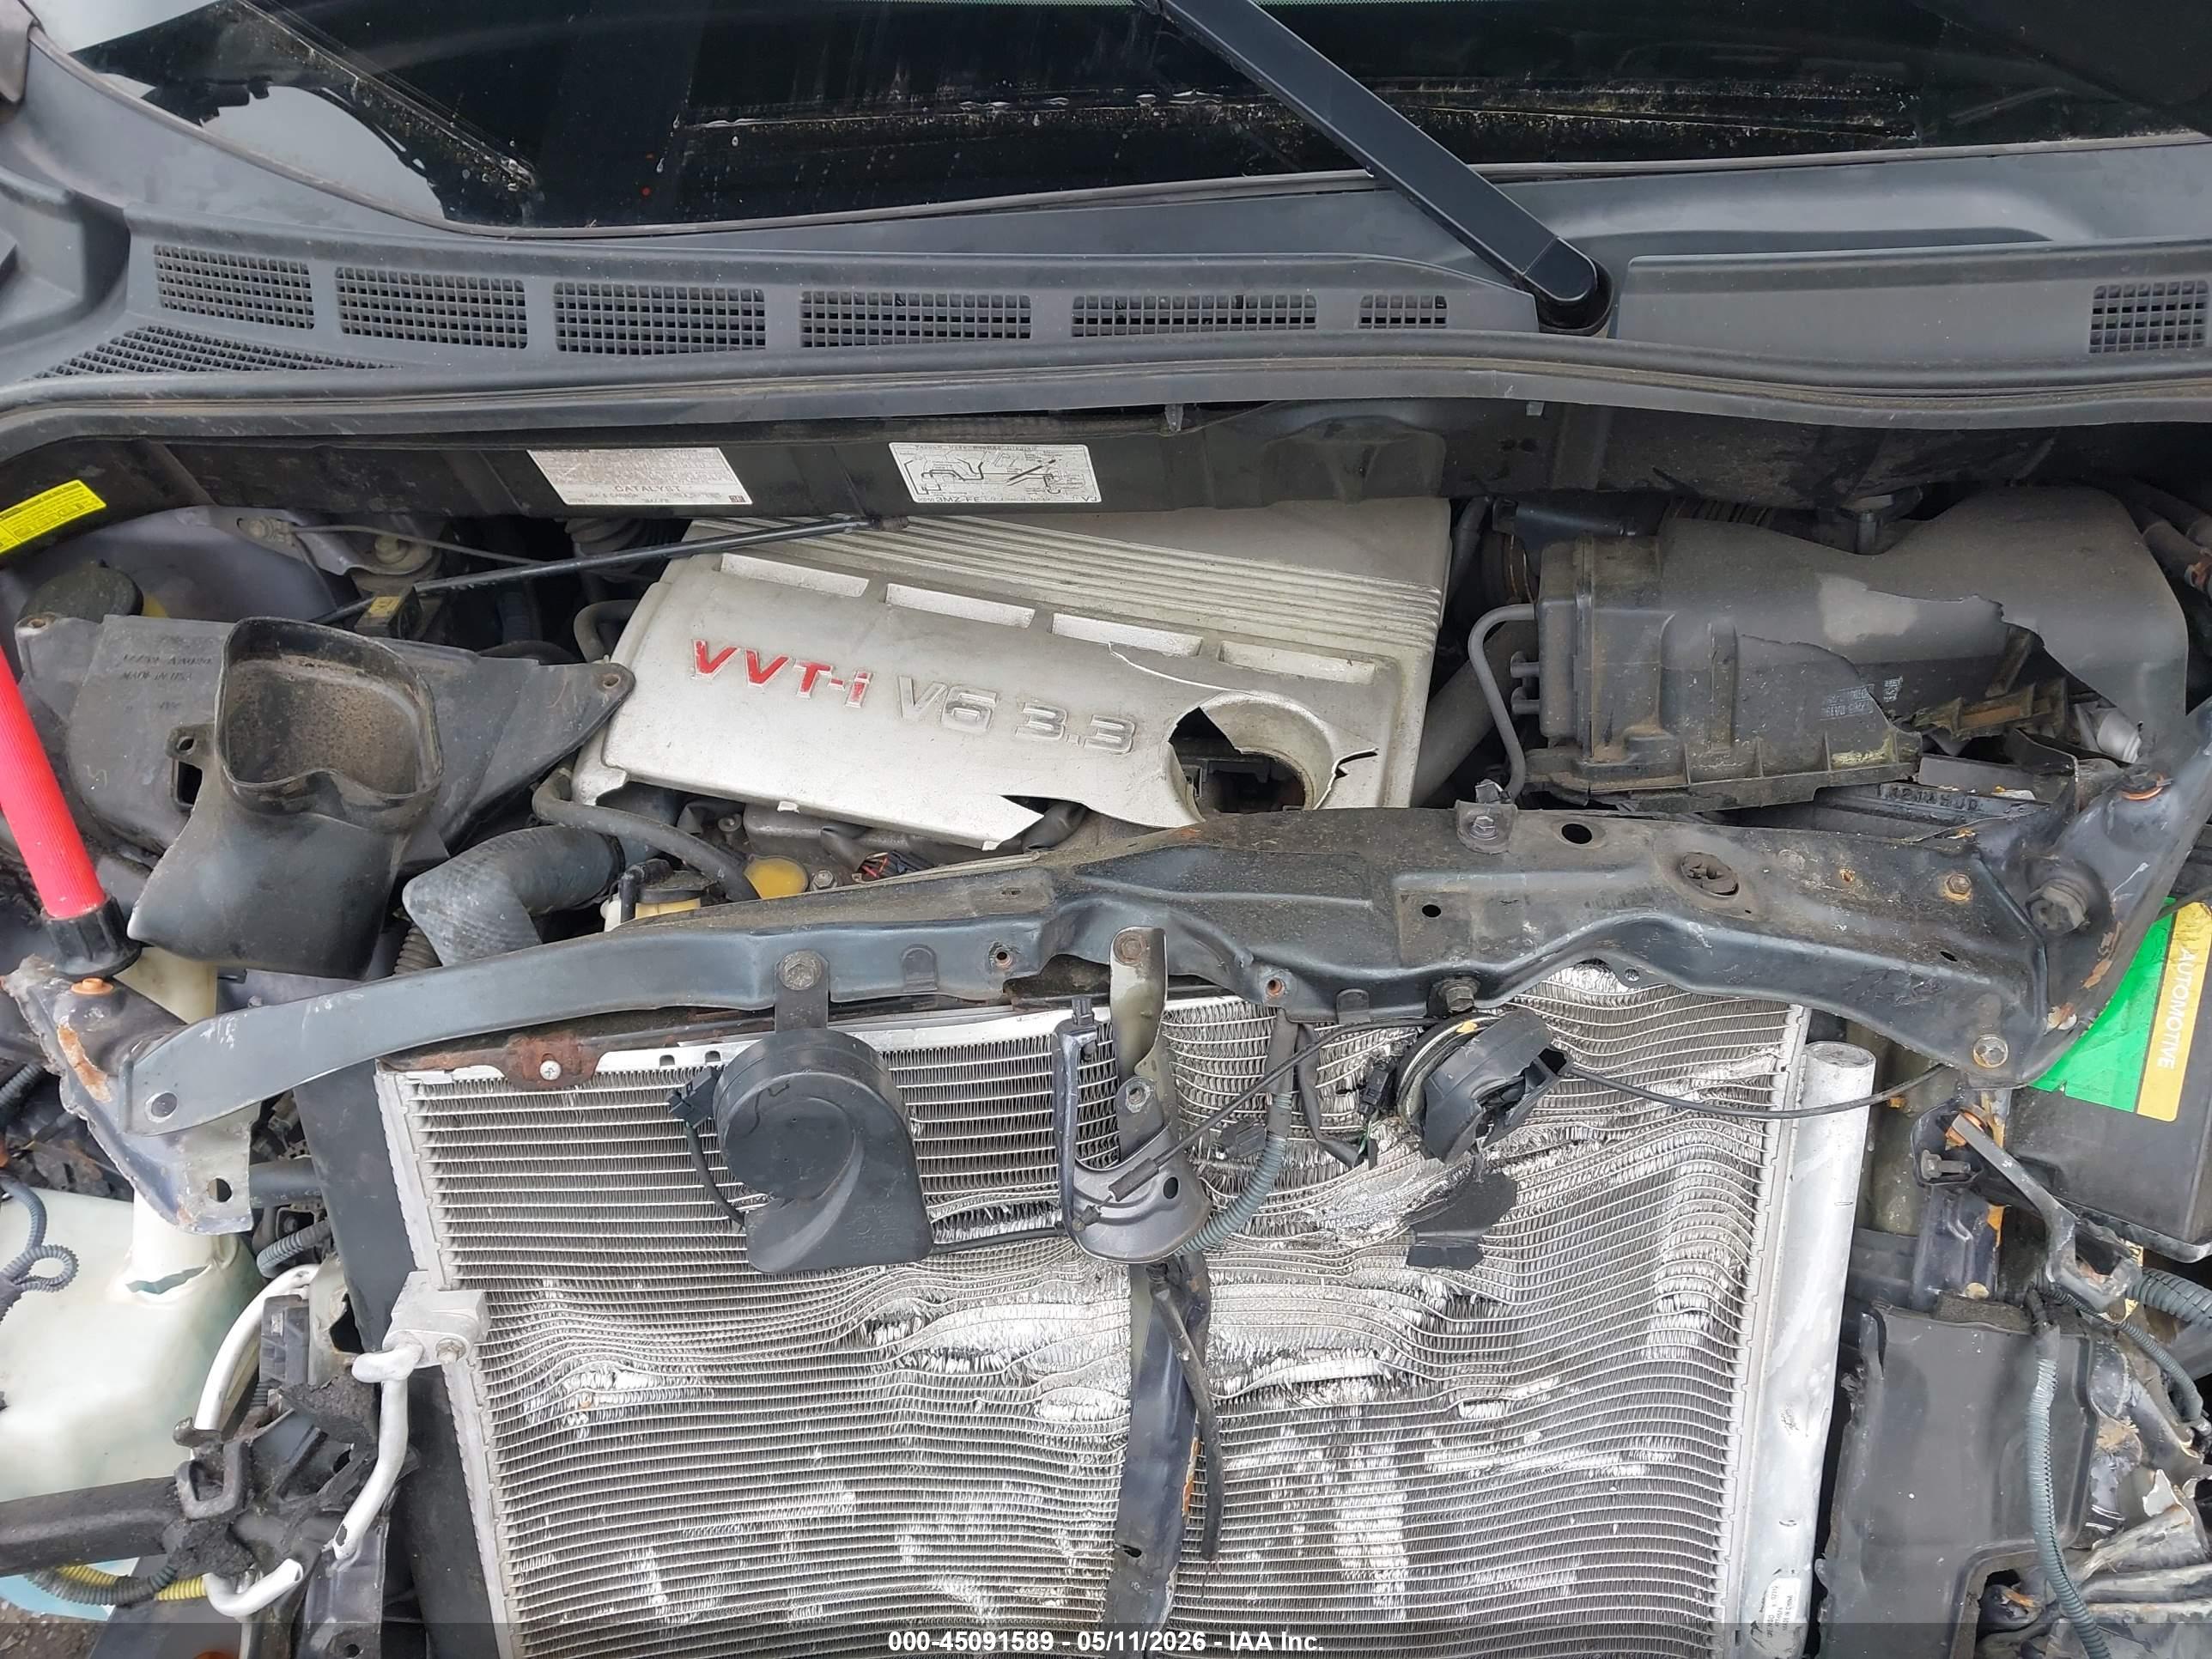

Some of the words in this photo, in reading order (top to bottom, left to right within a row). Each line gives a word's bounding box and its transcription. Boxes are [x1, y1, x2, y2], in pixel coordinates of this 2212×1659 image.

[614, 484, 682, 493] CATALYST
[690, 637, 874, 709] VVT-i
[896, 675, 1000, 735] V6
[1014, 699, 1138, 756] 3.3
[2156, 946, 2196, 1069] AUTOMOTIVE
